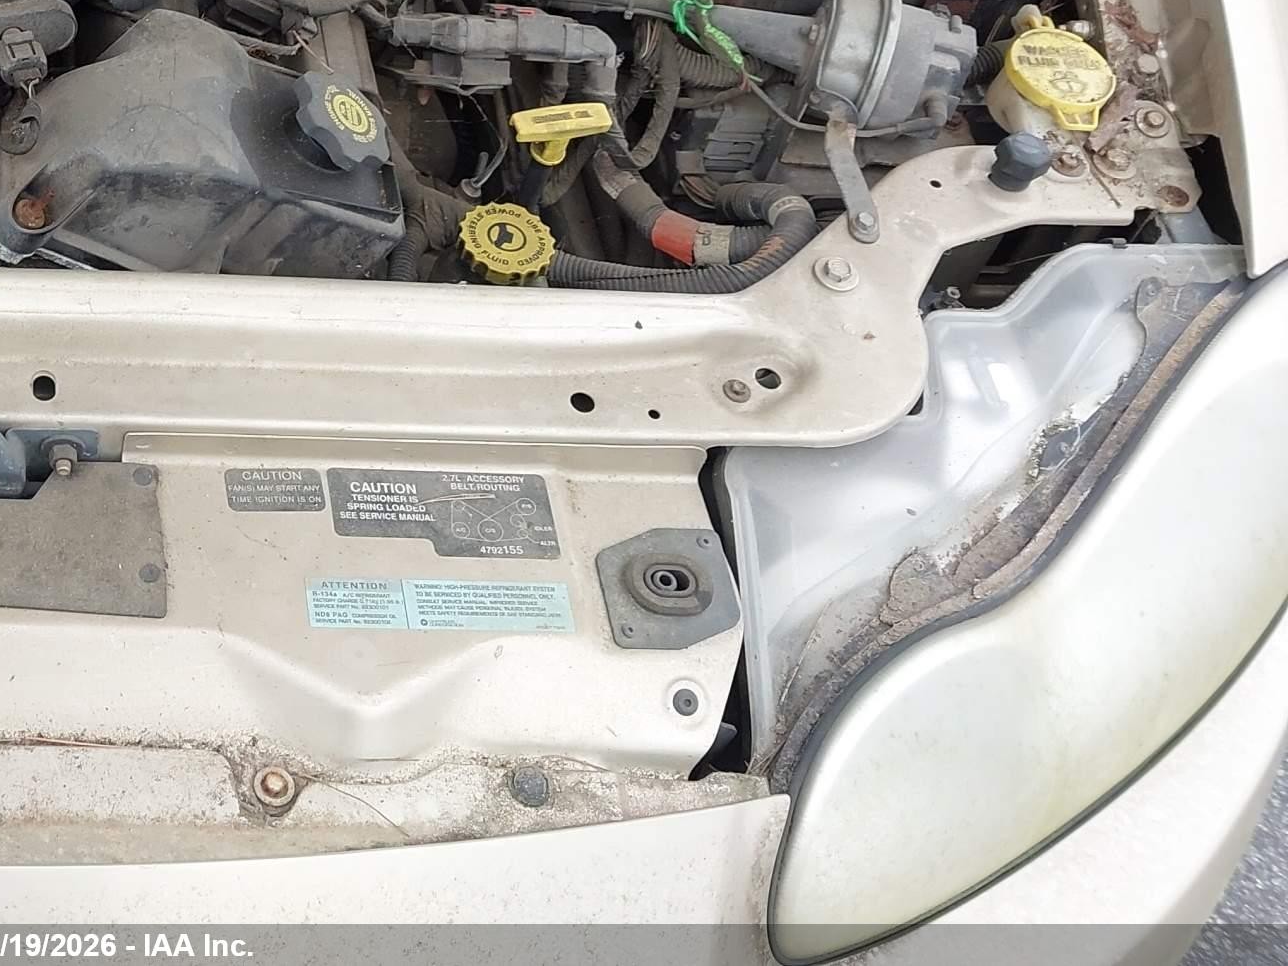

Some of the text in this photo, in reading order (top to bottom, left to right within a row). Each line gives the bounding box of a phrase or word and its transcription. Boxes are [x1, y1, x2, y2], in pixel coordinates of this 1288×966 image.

[481, 250, 509, 266] FLUID
[242, 471, 303, 481] CAUTION
[442, 474, 525, 484] 2.7L ACCESSORY
[257, 484, 274, 493] MAY
[276, 485, 301, 493] START
[303, 485, 321, 493] ANY
[350, 482, 416, 495] CAUTION
[477, 484, 520, 492] ROUTING
[352, 494, 419, 503] TENSIONER IS
[347, 503, 426, 512] SPRING LOADED
[339, 511, 436, 522] SEE SERVICE MANUAL
[322, 581, 388, 590] ATTENTION
